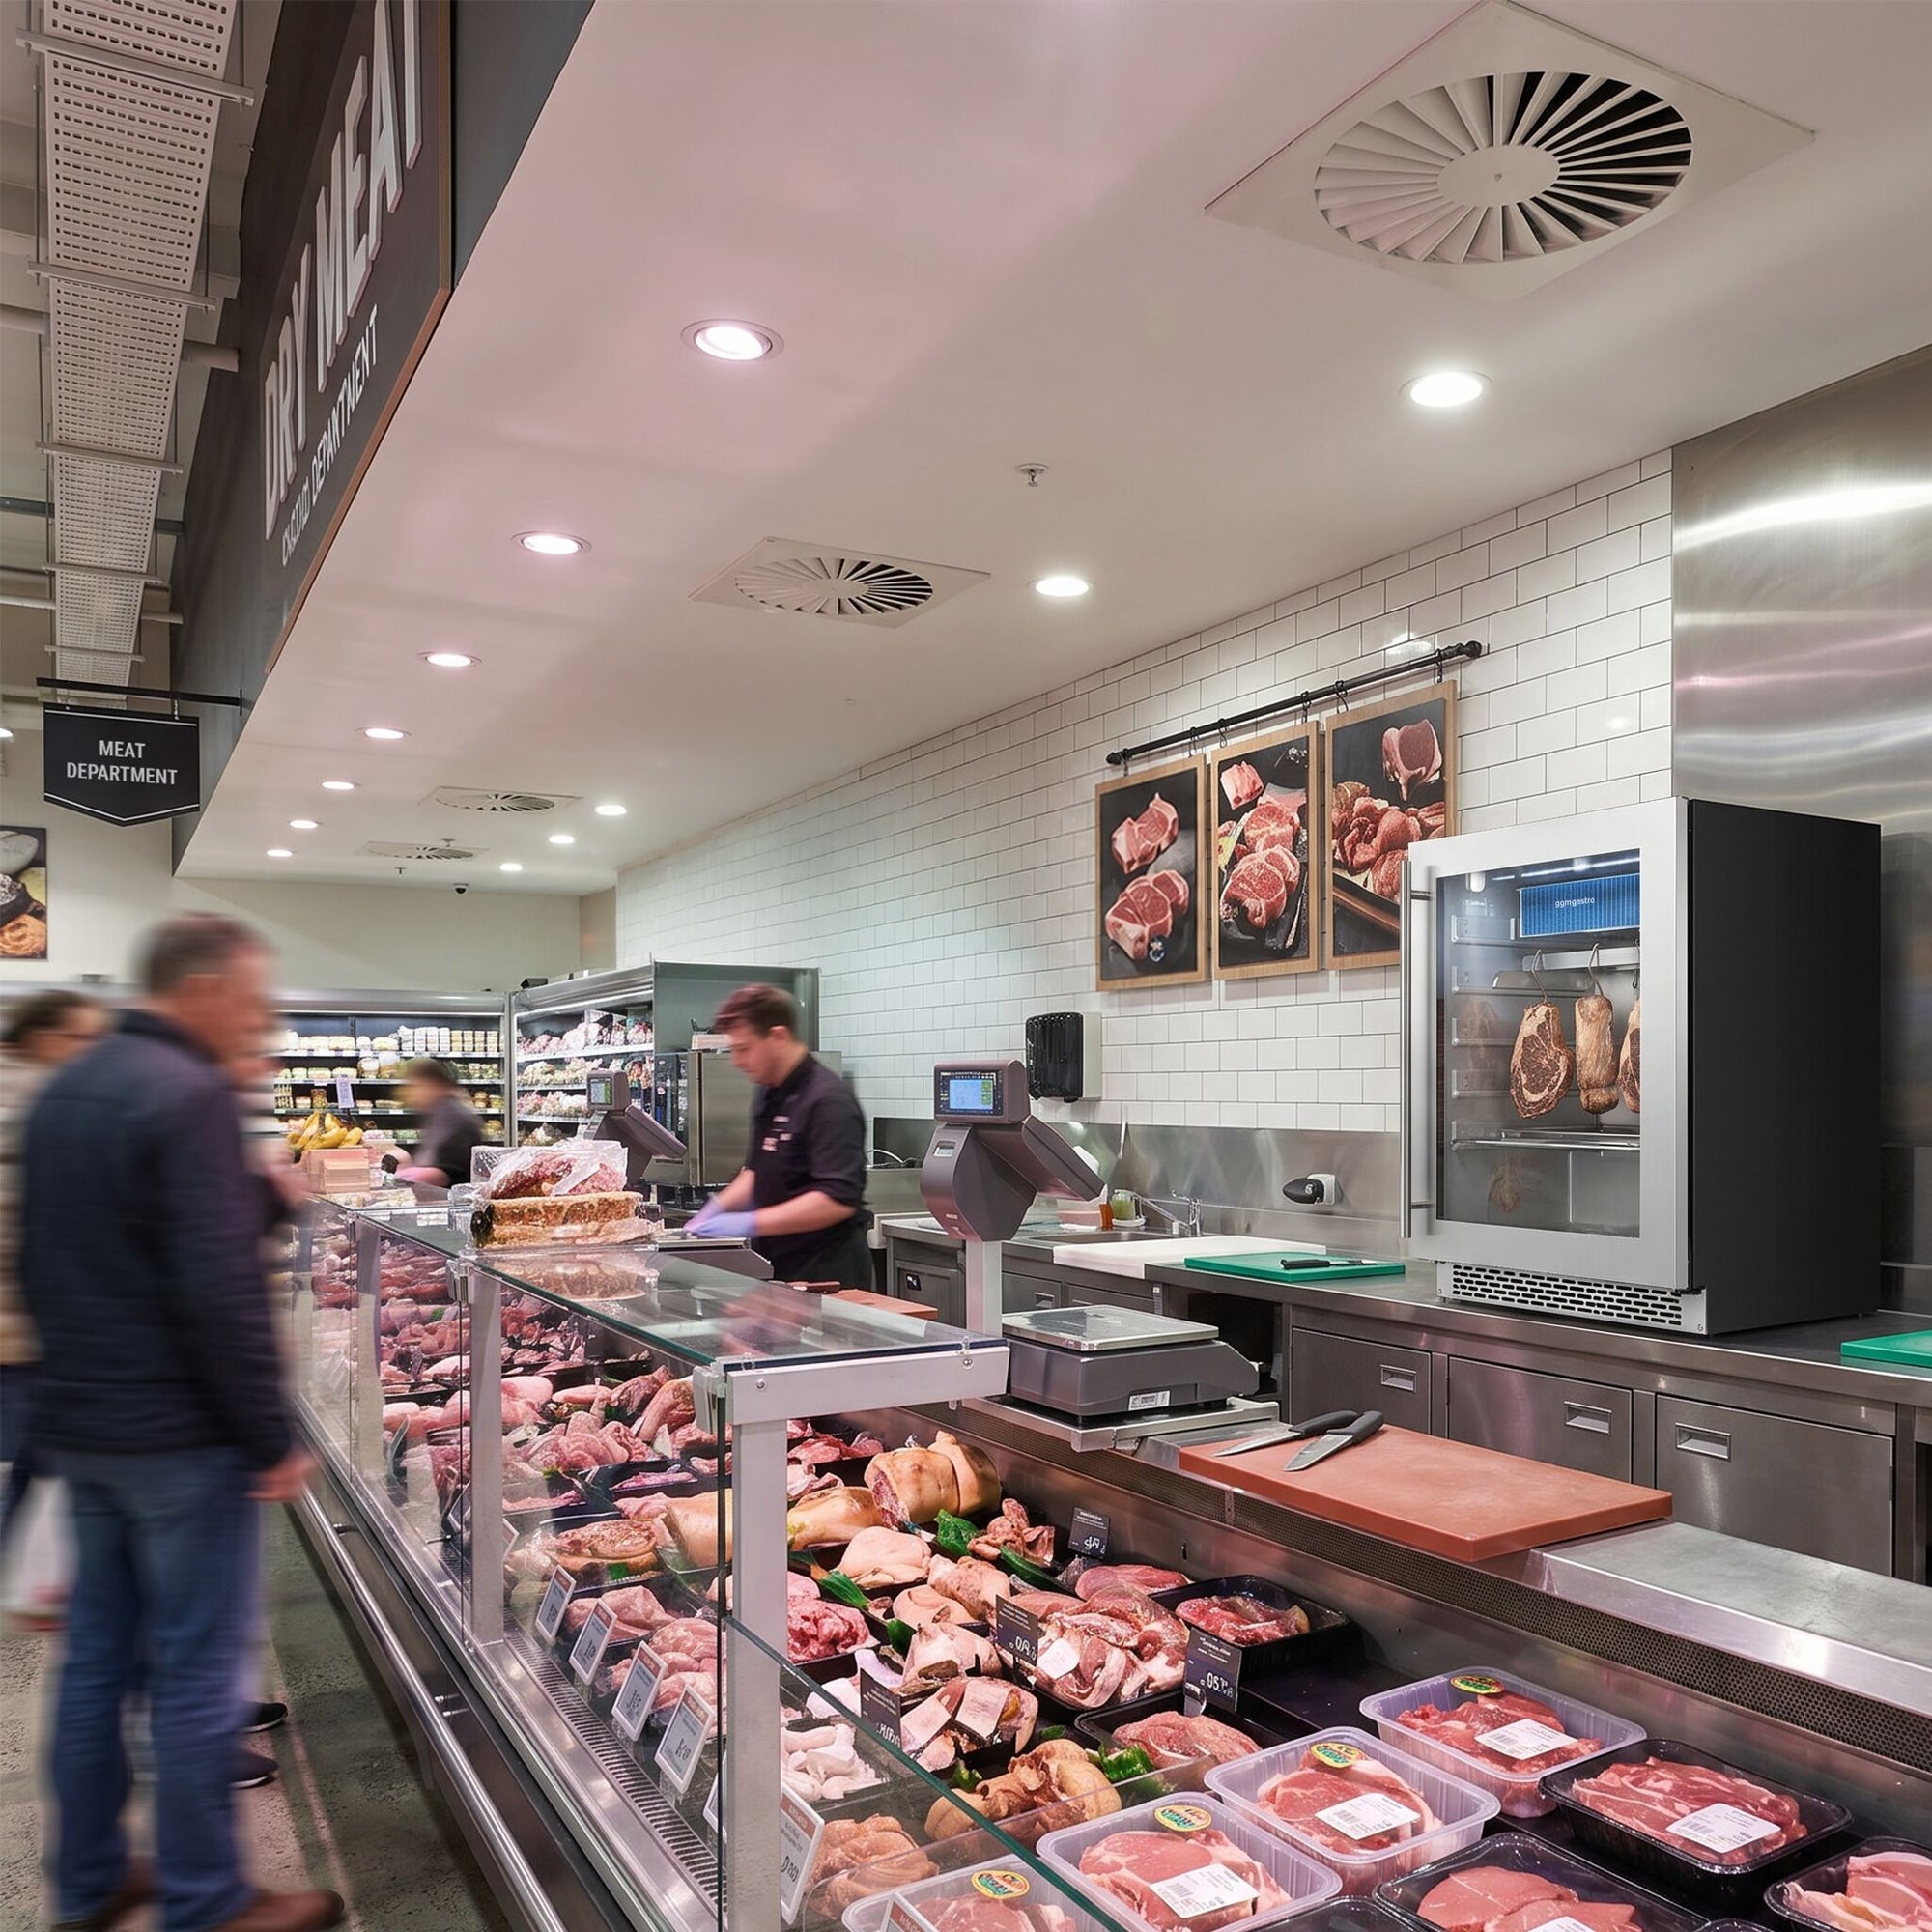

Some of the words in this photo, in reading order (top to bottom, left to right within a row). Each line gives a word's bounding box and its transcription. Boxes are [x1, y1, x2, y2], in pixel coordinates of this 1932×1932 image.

[265, 242, 312, 541] DRY
[99, 740, 145, 758] MEAT
[66, 762, 178, 784] DEPARTMENT
[1554, 896, 1596, 908] ggmgastro
